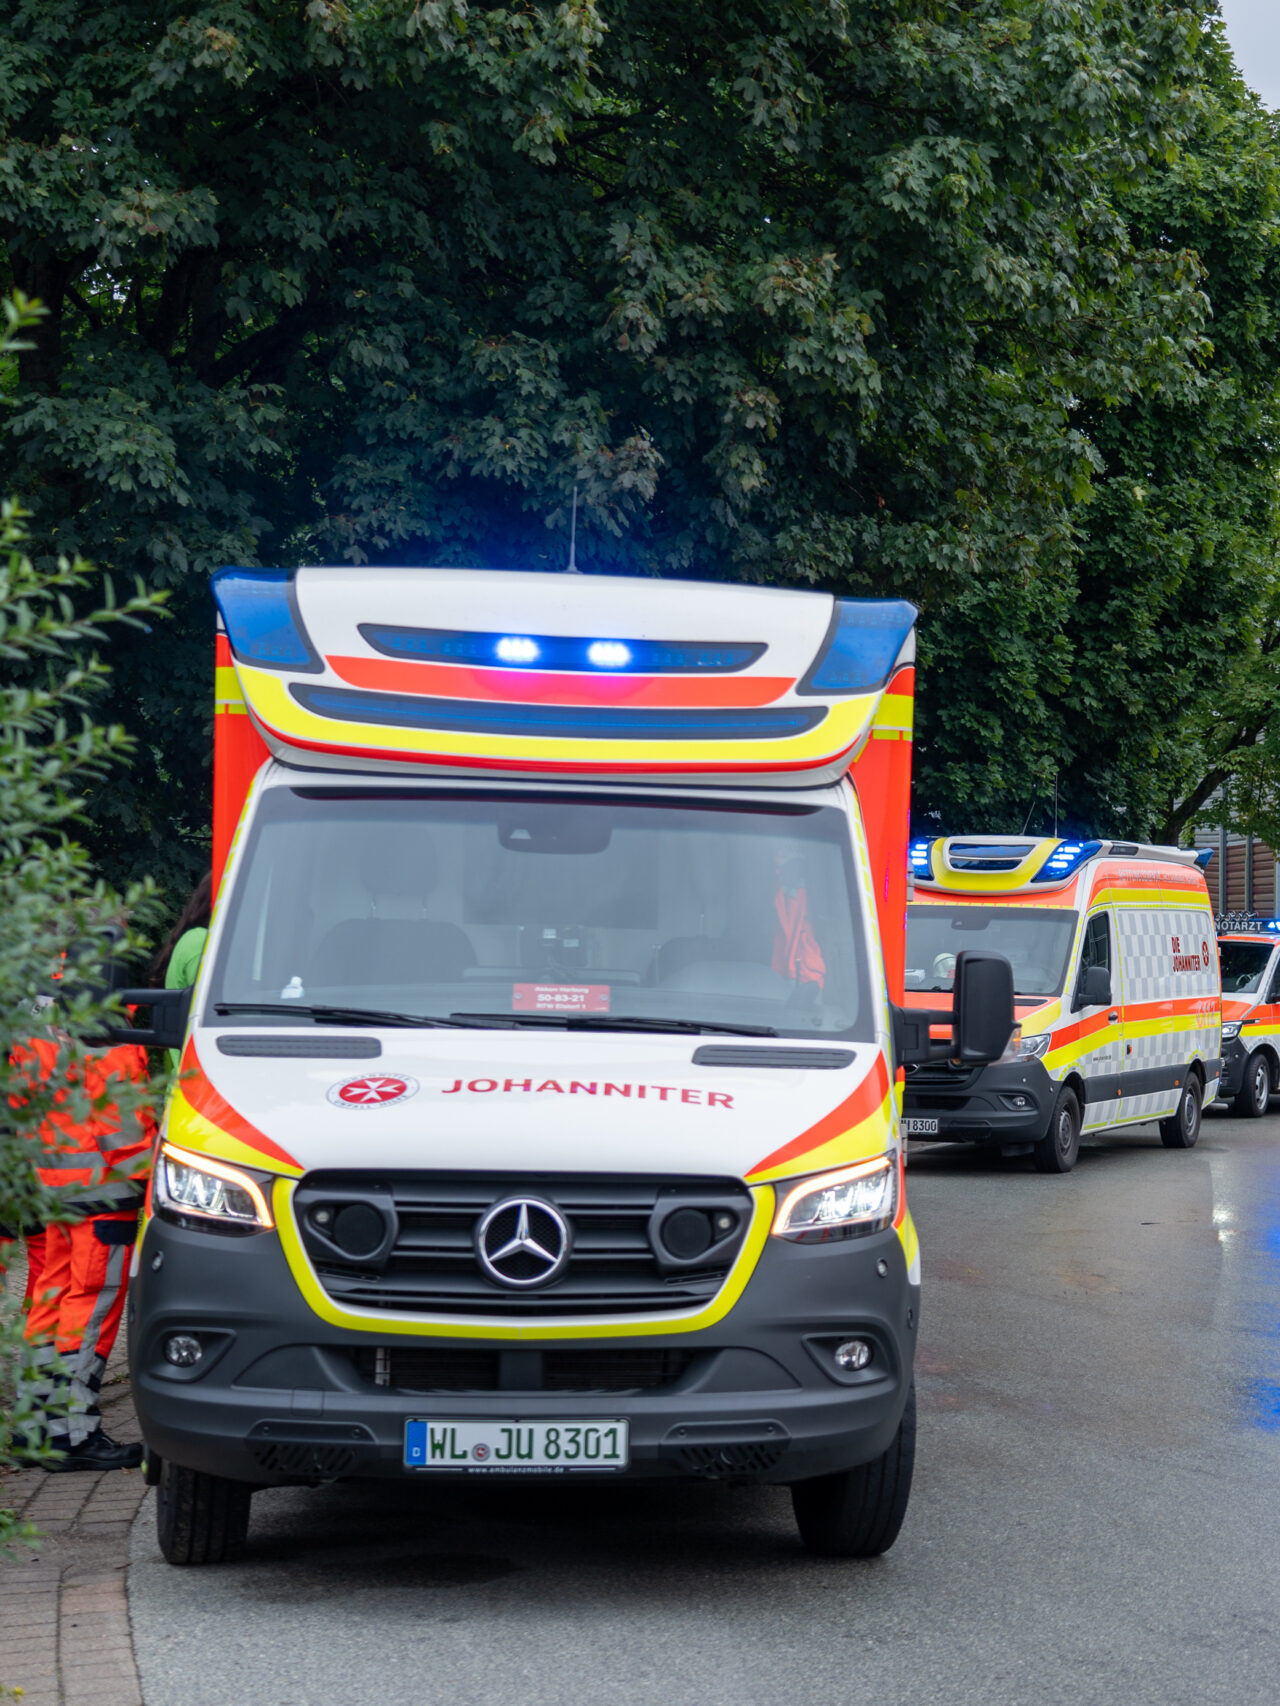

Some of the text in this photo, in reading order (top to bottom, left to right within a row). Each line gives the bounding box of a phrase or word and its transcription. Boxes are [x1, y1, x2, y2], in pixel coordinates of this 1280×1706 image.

[1215, 921, 1262, 931] NOTARZT
[1171, 936, 1180, 953] DIE
[1173, 954, 1201, 972] JOHANNITER
[537, 994, 584, 1002] 50-83-21
[441, 1078, 735, 1109] JOHANNITER
[912, 1120, 937, 1131] 8300
[412, 1427, 621, 1460] D WL JU 8301
[467, 1466, 565, 1474] www.ambulanzmobile.de
